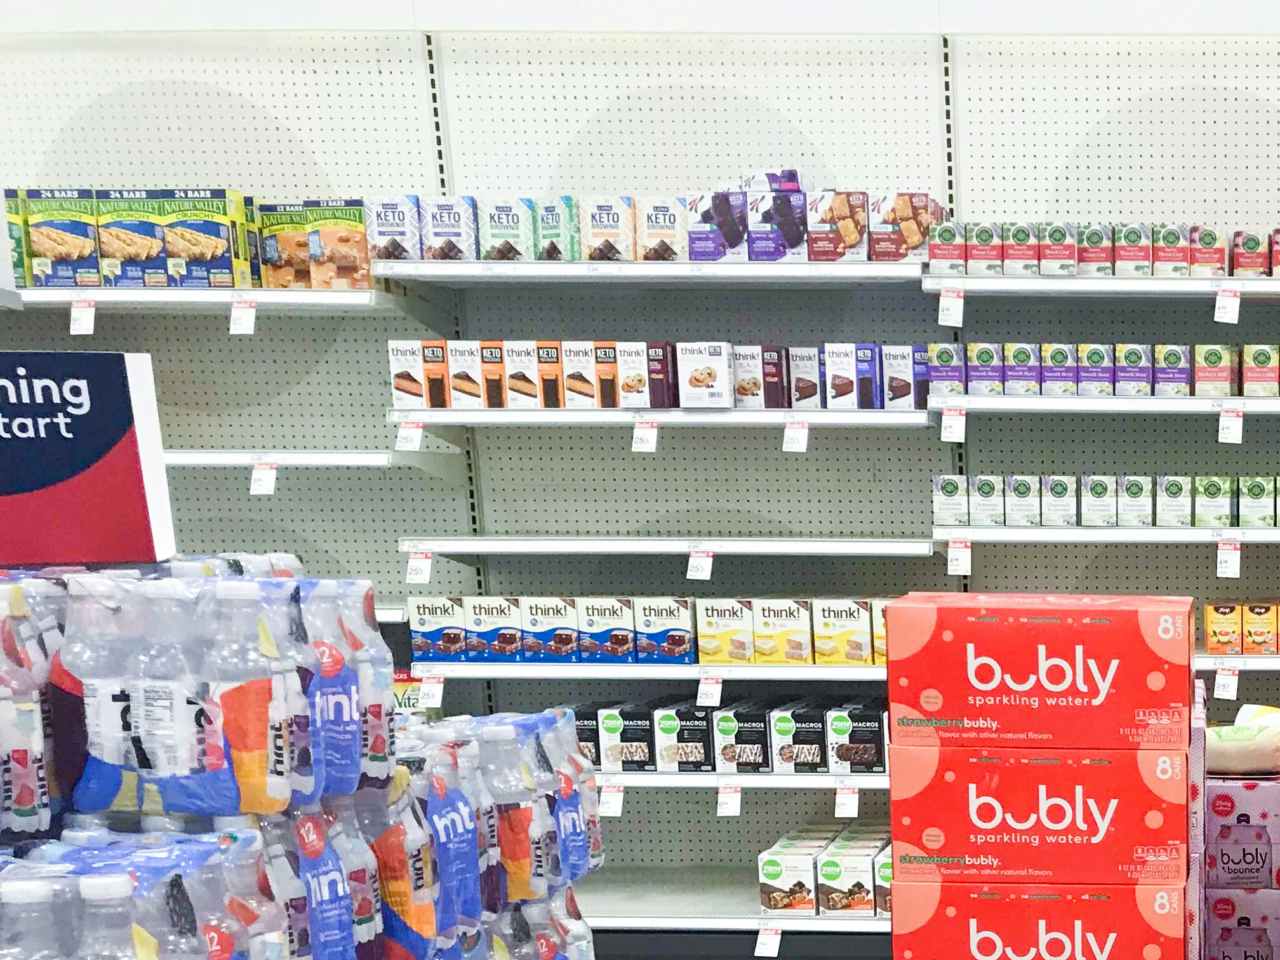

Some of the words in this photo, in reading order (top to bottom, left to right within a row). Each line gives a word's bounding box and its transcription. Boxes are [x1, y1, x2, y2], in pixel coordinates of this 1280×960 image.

[99, 201, 128, 213] NATURE
[129, 201, 160, 213] VALLEY
[163, 201, 192, 213] NATURE
[193, 201, 225, 213] VALLEY
[376, 210, 405, 223] KETO
[432, 211, 461, 223] KETO
[489, 213, 519, 225] KETO
[541, 213, 560, 224] KETO
[591, 211, 620, 223] KETO
[647, 213, 677, 225] KETO
[391, 347, 420, 357] think!
[450, 347, 479, 357] think!
[507, 347, 536, 357] think!
[564, 347, 592, 358] think!
[735, 351, 760, 361] think!
[791, 352, 816, 362] think!
[885, 351, 911, 361] think!
[416, 604, 455, 616] think!
[473, 604, 511, 616] think!
[529, 604, 568, 616] think!
[586, 604, 624, 617] think!
[643, 605, 680, 618] think!
[705, 606, 744, 619] think!
[762, 606, 800, 619] think!
[822, 606, 861, 620] think!
[1158, 615, 1175, 640] 8
[966, 643, 1120, 706] bubly
[968, 694, 1039, 708] sparkling
[1046, 695, 1089, 705] water
[680, 720, 707, 728] MACROS
[739, 721, 765, 729] MACROS
[1156, 756, 1173, 780] 8
[968, 784, 1119, 843] bubly
[301, 822, 316, 844] 12
[969, 831, 1039, 846] sparkling
[1045, 834, 1089, 843] water
[1220, 848, 1268, 869] bubly
[1154, 891, 1170, 914] 8
